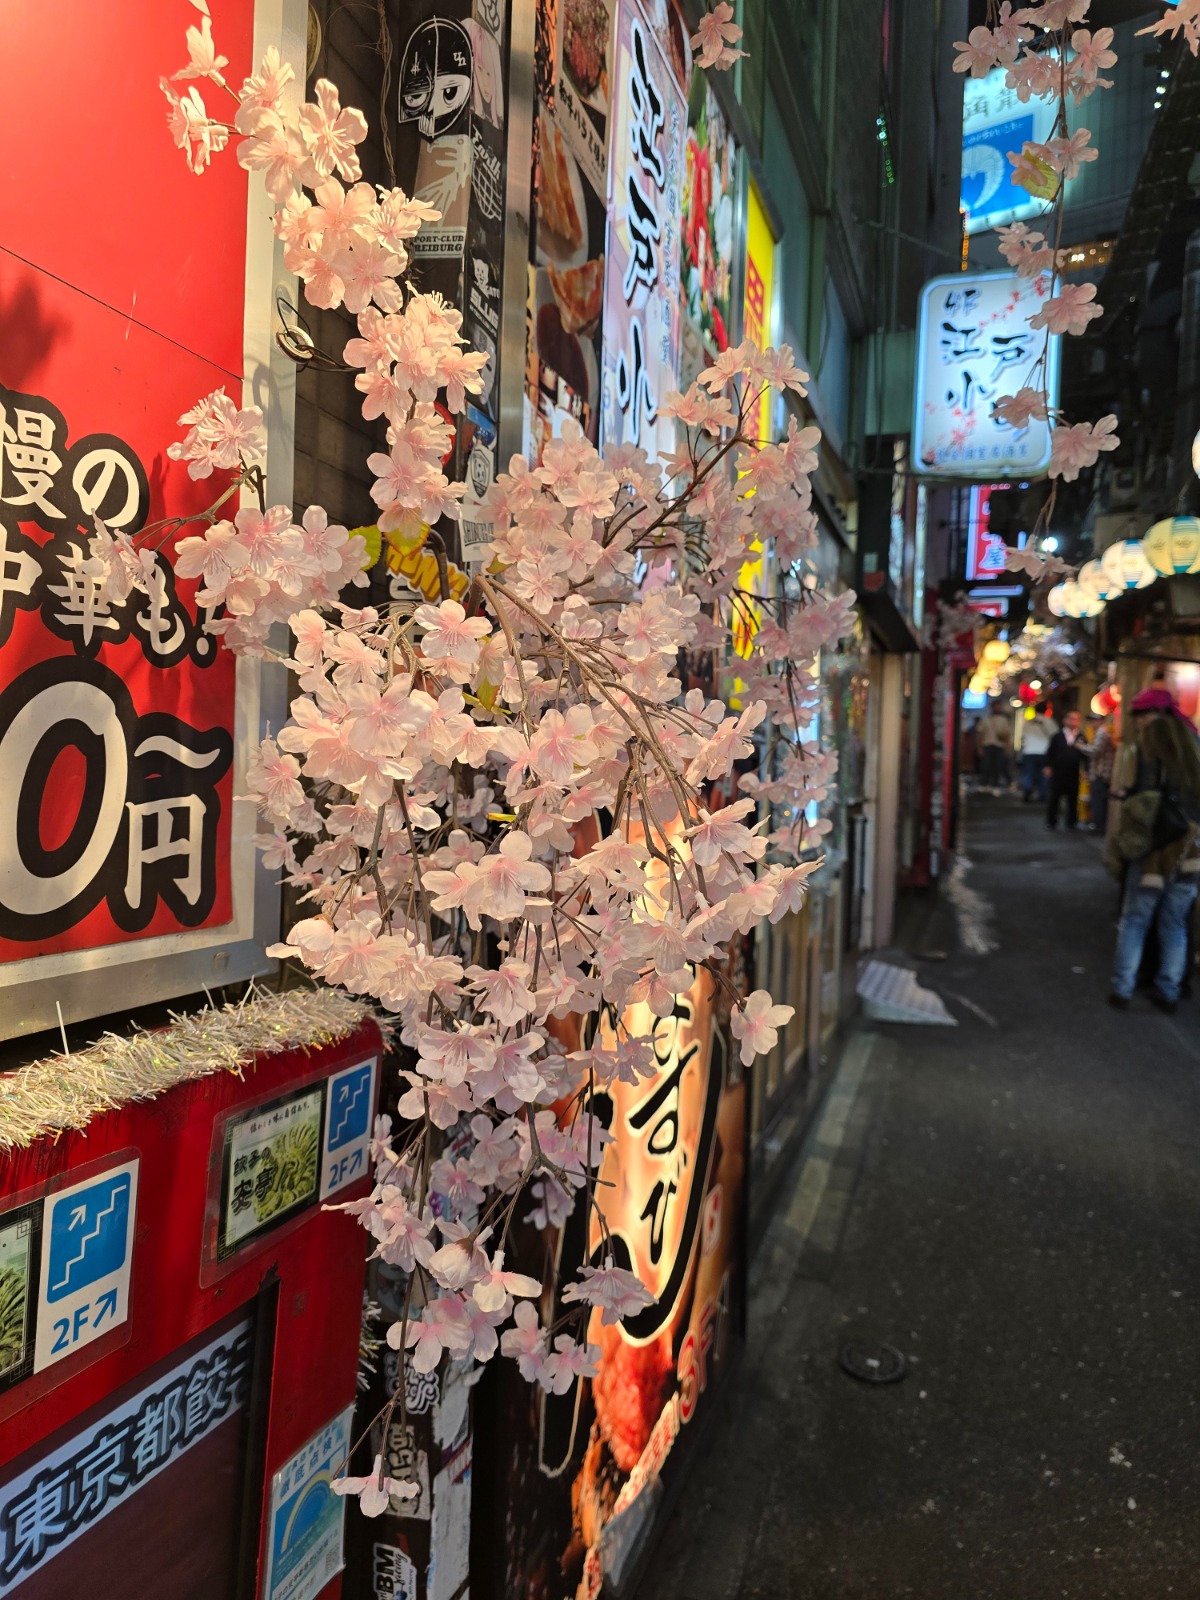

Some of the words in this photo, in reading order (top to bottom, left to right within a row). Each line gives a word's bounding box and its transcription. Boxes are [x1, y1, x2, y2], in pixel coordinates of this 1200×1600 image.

[414, 235, 464, 243] PORT-CLUB
[415, 243, 463, 252] REIBURG
[328, 1155, 349, 1190] 2F
[50, 1303, 90, 1355] 2F
